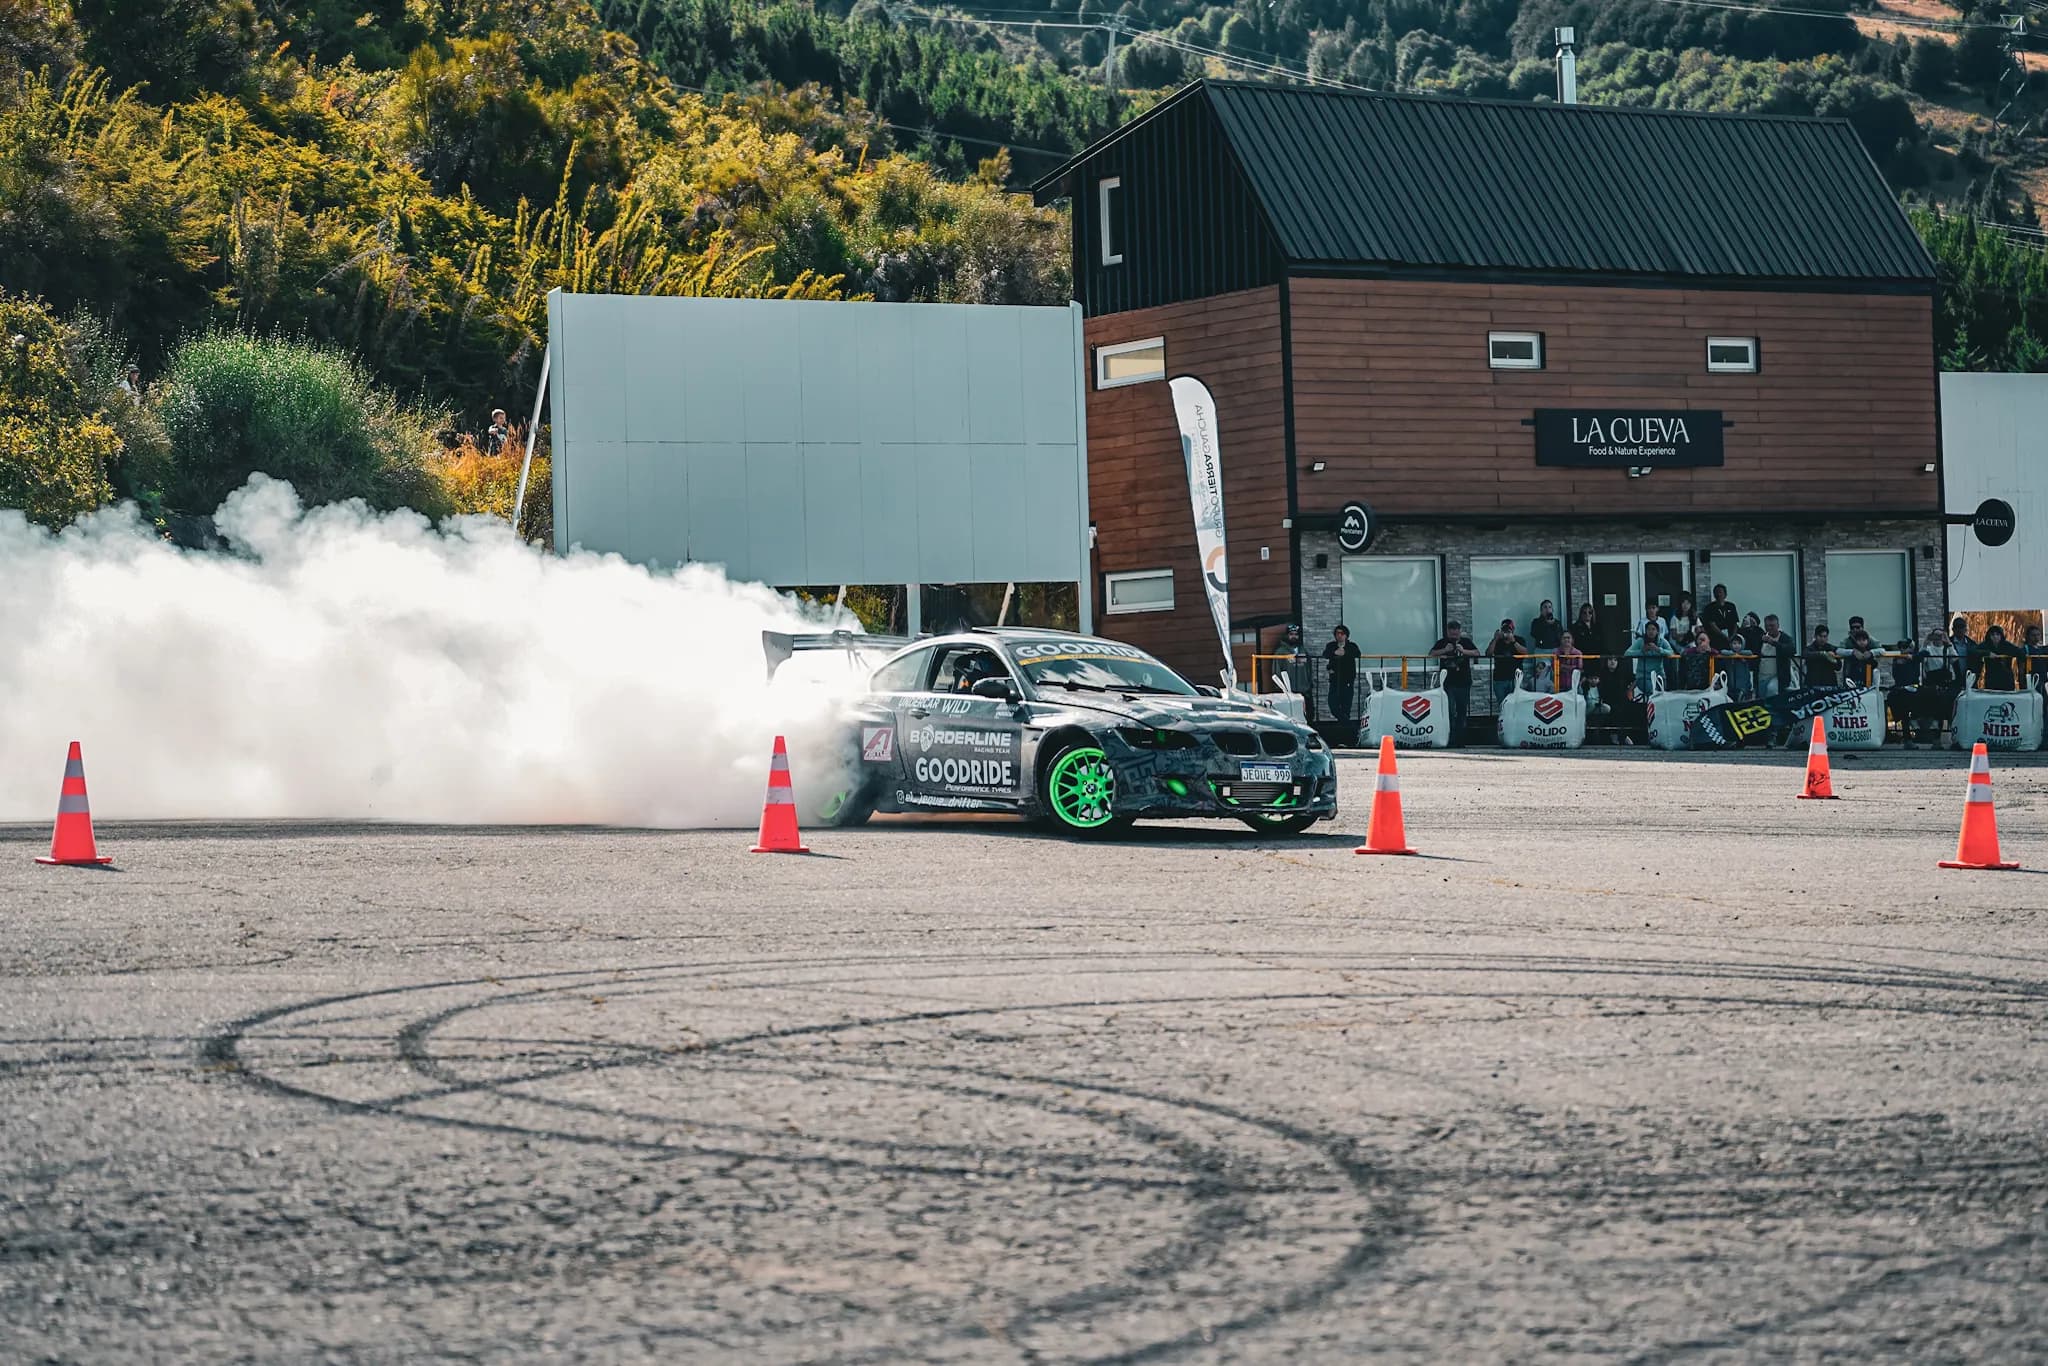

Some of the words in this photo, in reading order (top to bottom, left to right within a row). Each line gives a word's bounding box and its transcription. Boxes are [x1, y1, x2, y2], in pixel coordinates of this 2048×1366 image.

[1572, 418, 1605, 443] LA
[1610, 418, 1690, 443] CUEVA
[1588, 446, 1607, 456] Food
[1608, 446, 1614, 456] &
[1615, 446, 1638, 456] Nature
[1639, 446, 1676, 457] Experience
[941, 699, 971, 714] WILD
[1832, 716, 1868, 729] NIRE
[1983, 722, 2020, 736] NIRE
[1395, 723, 1434, 737] SÓLIDO
[1527, 723, 1567, 737] SÓLIDO
[909, 728, 1012, 750] BORDERLINE
[915, 757, 1013, 786] GOODRIDE
[1243, 769, 1272, 781] JEQUE
[1274, 770, 1291, 781] 999
